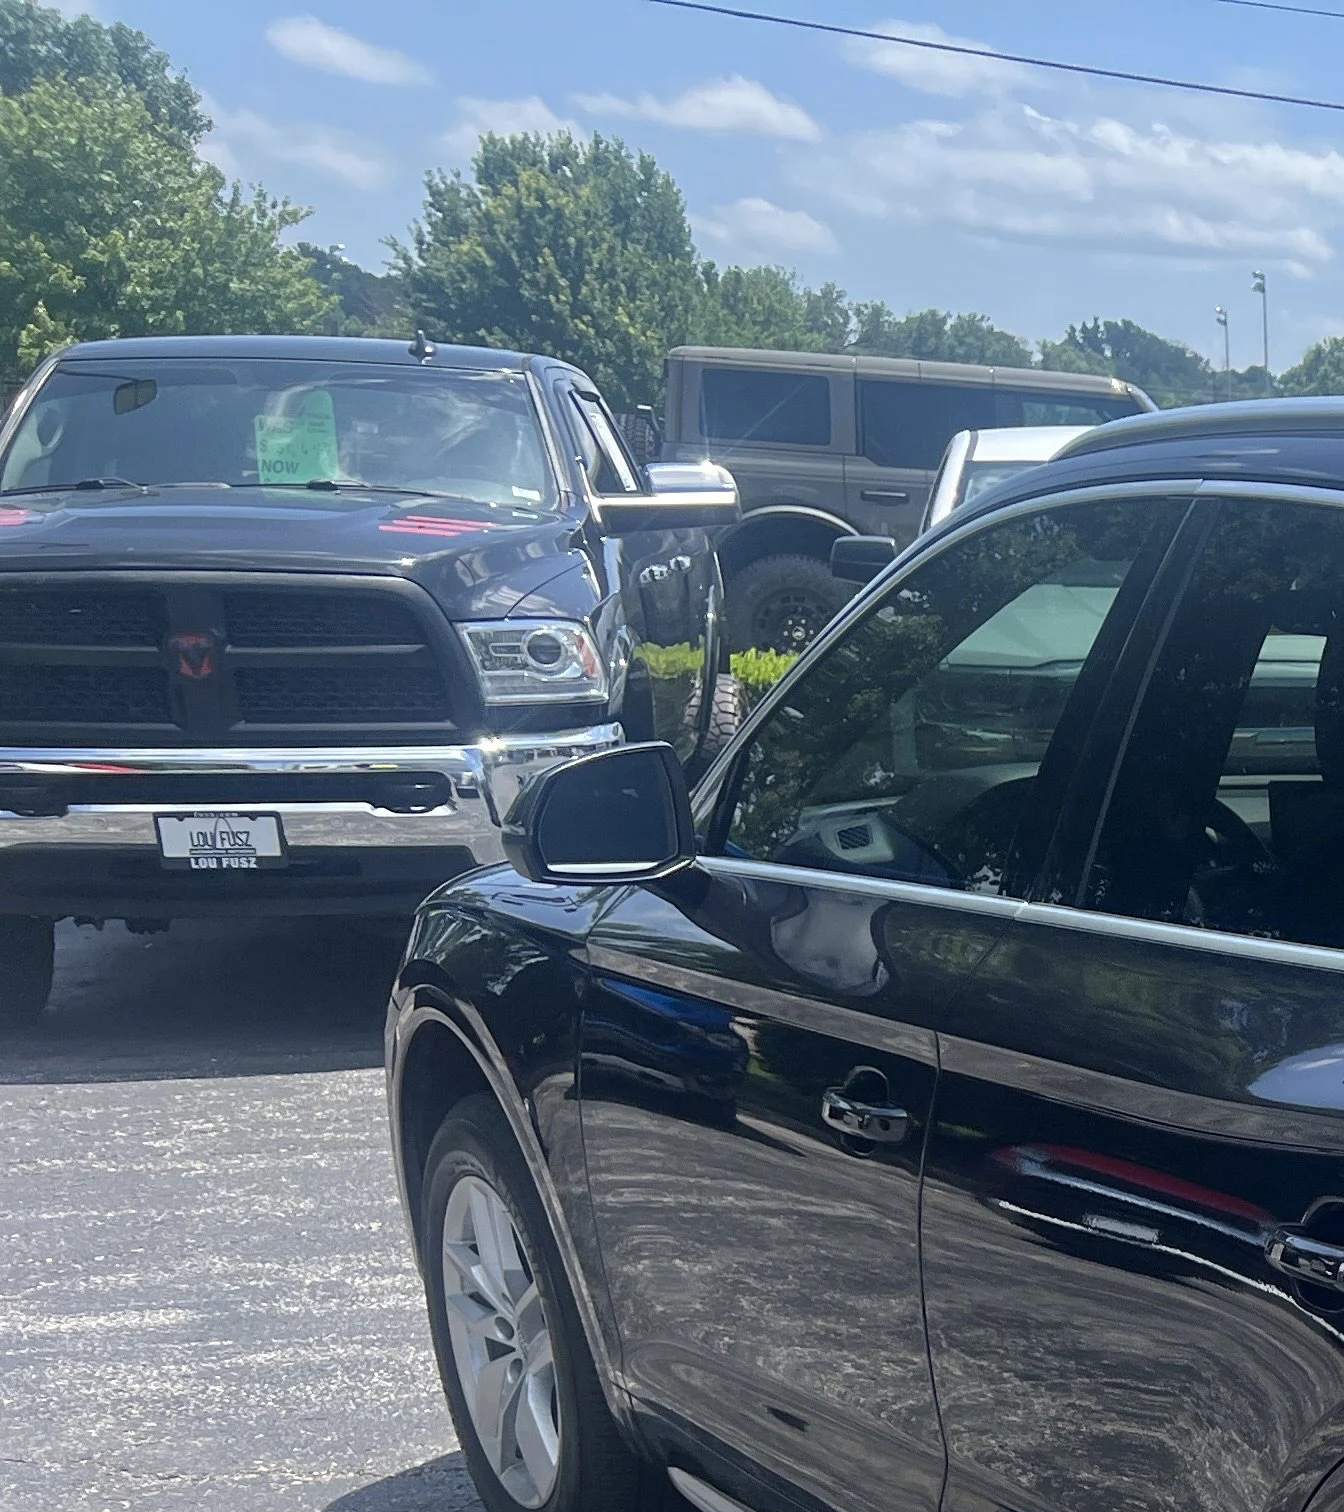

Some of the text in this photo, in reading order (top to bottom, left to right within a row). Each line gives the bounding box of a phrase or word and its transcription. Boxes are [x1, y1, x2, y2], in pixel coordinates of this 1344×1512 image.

[261, 460, 300, 474] NOW
[190, 831, 252, 847] LOU FUSZ
[190, 857, 258, 869] LOU FUSZ
